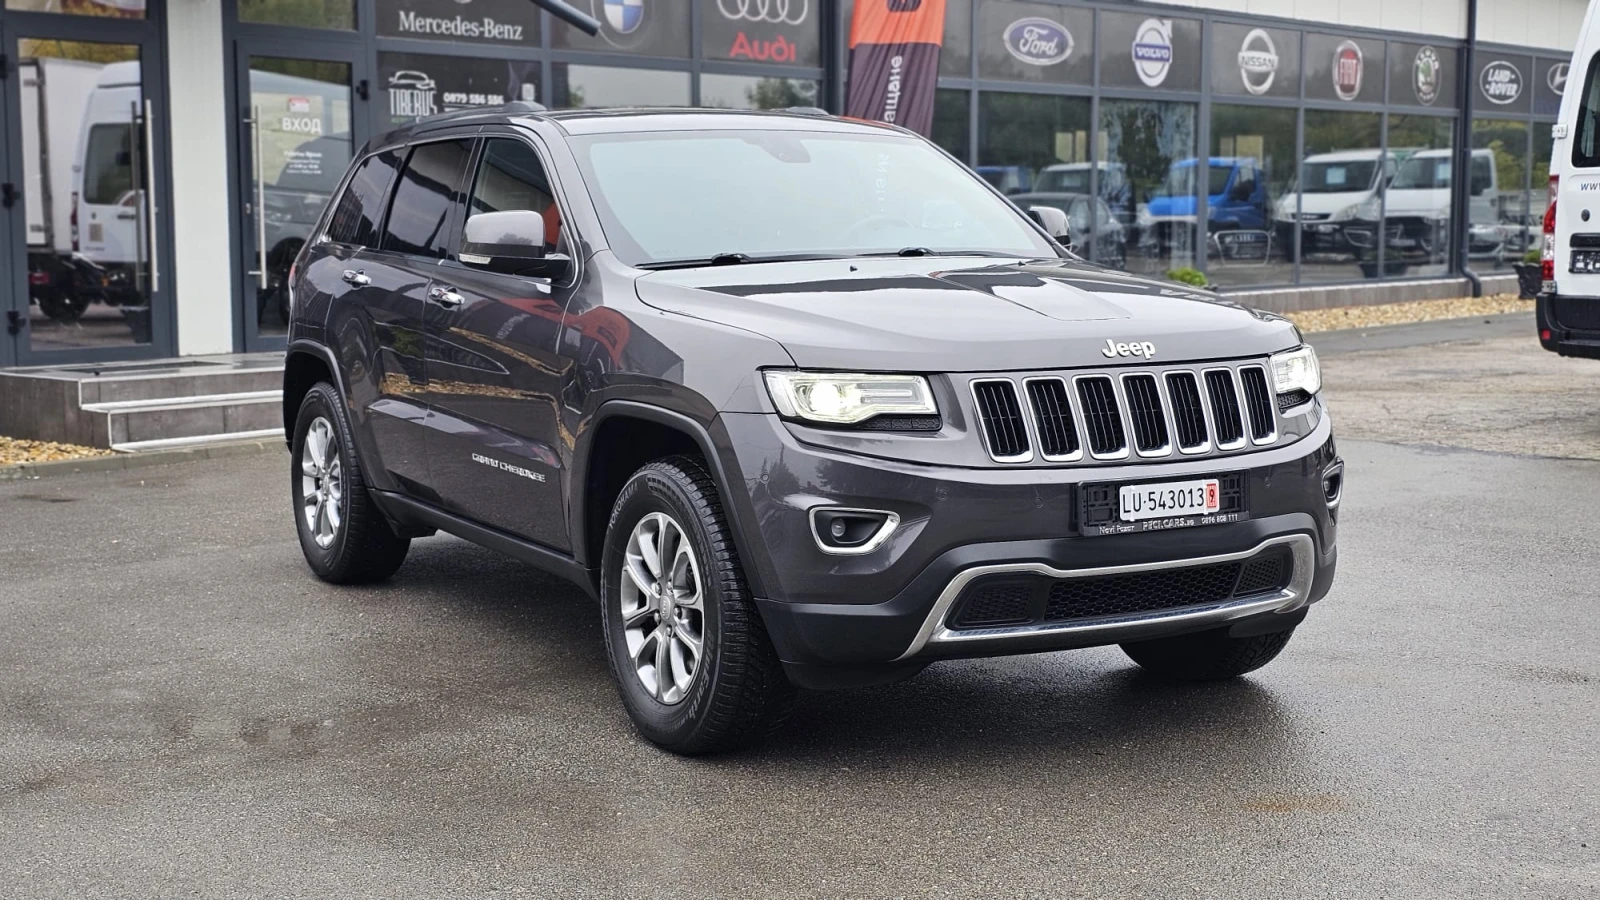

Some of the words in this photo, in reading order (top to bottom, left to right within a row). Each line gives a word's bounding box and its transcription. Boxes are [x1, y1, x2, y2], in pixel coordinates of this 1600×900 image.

[398, 11, 523, 41] Mercedes-Benz
[729, 31, 796, 62] Audi
[1019, 26, 1058, 56] Ford
[1136, 47, 1170, 59] VOLVO
[1240, 55, 1276, 69] NISSAN
[1488, 82, 1519, 97] ROVER
[282, 117, 322, 135] ВХОД
[1101, 338, 1156, 360] Jeep
[472, 452, 499, 467] GRAND
[499, 461, 546, 482] CHEROKEE
